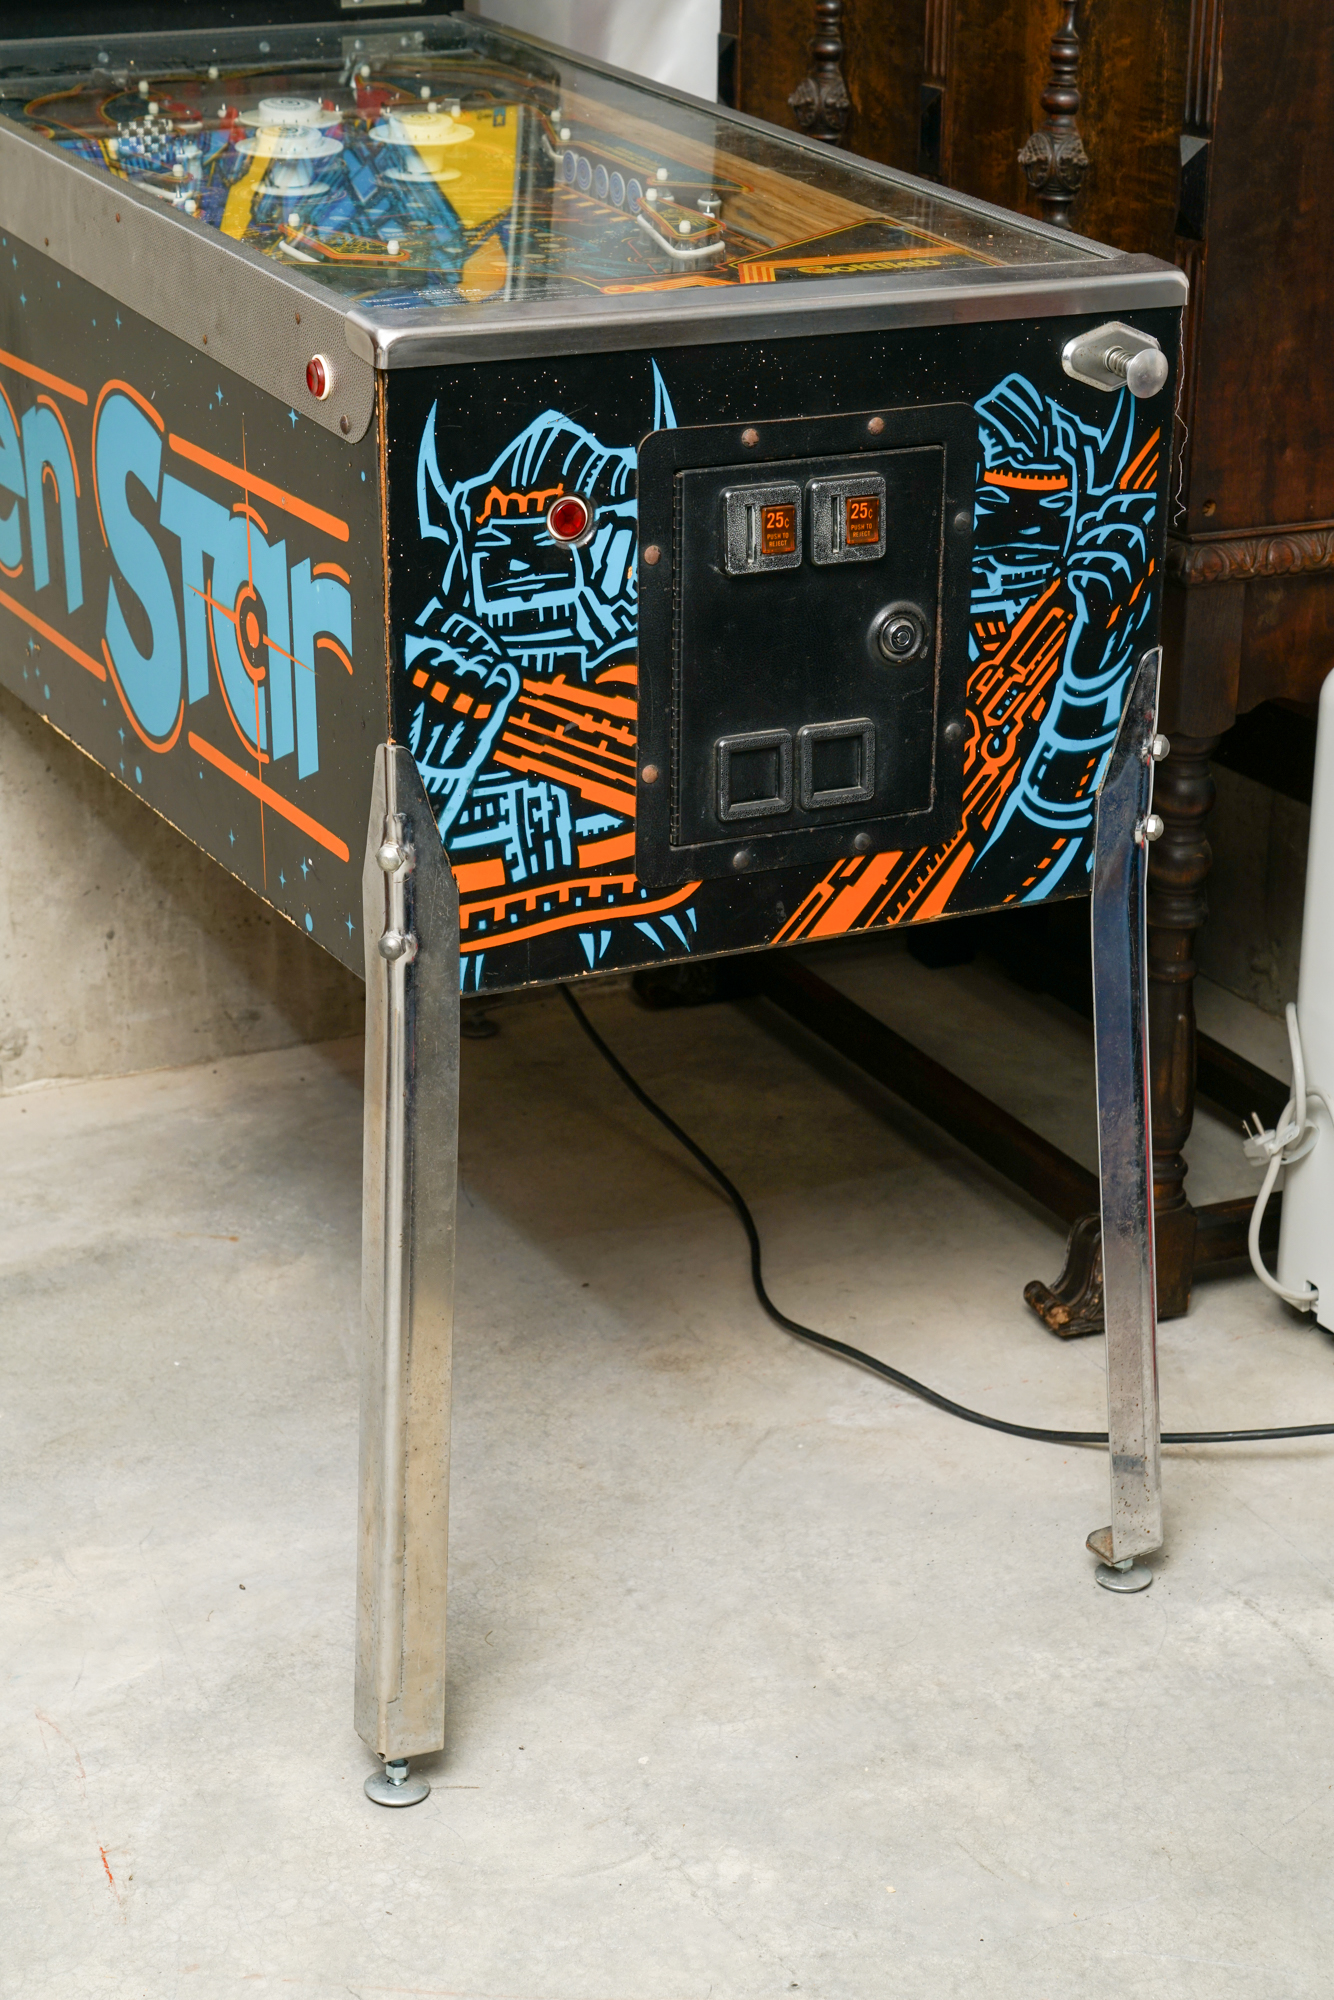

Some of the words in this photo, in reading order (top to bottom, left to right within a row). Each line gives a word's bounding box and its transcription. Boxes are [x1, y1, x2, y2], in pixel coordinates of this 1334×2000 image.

[797, 259, 942, 274] Gottlieb
[851, 503, 873, 519] 25¢
[767, 512, 790, 529] 25¢
[851, 523, 865, 531] PUSH
[866, 522, 873, 530] TO
